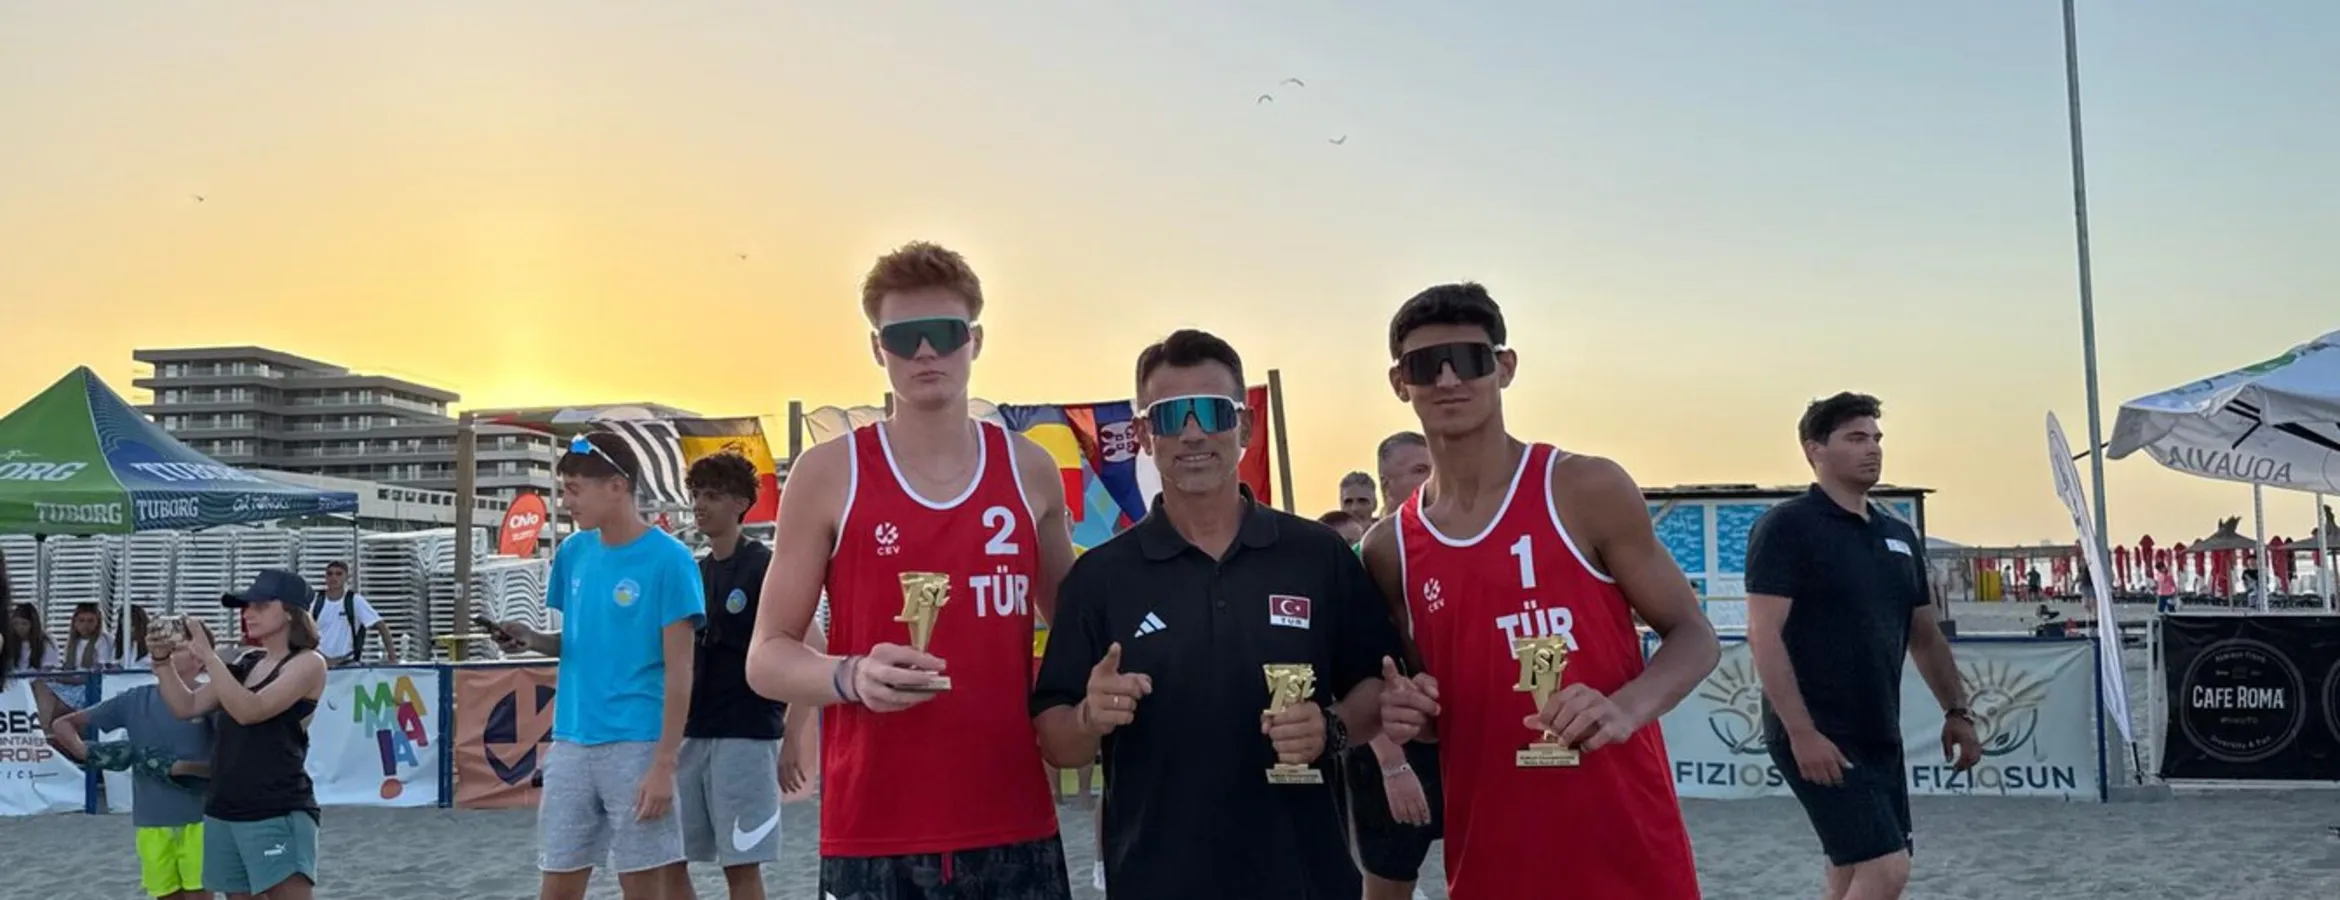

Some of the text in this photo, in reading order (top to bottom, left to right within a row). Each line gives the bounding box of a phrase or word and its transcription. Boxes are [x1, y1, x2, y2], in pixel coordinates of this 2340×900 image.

[34, 502, 122, 524] TUBORG
[136, 497, 199, 521] TUBORG
[982, 505, 1019, 555] 2
[877, 545, 900, 556] CEV
[1510, 534, 1536, 589] 1
[969, 564, 1029, 617] TÜR
[1496, 599, 1579, 659] TÜR
[2193, 685, 2284, 709] CAFE ROMA
[1912, 765, 2077, 789] FIZIOSUN
